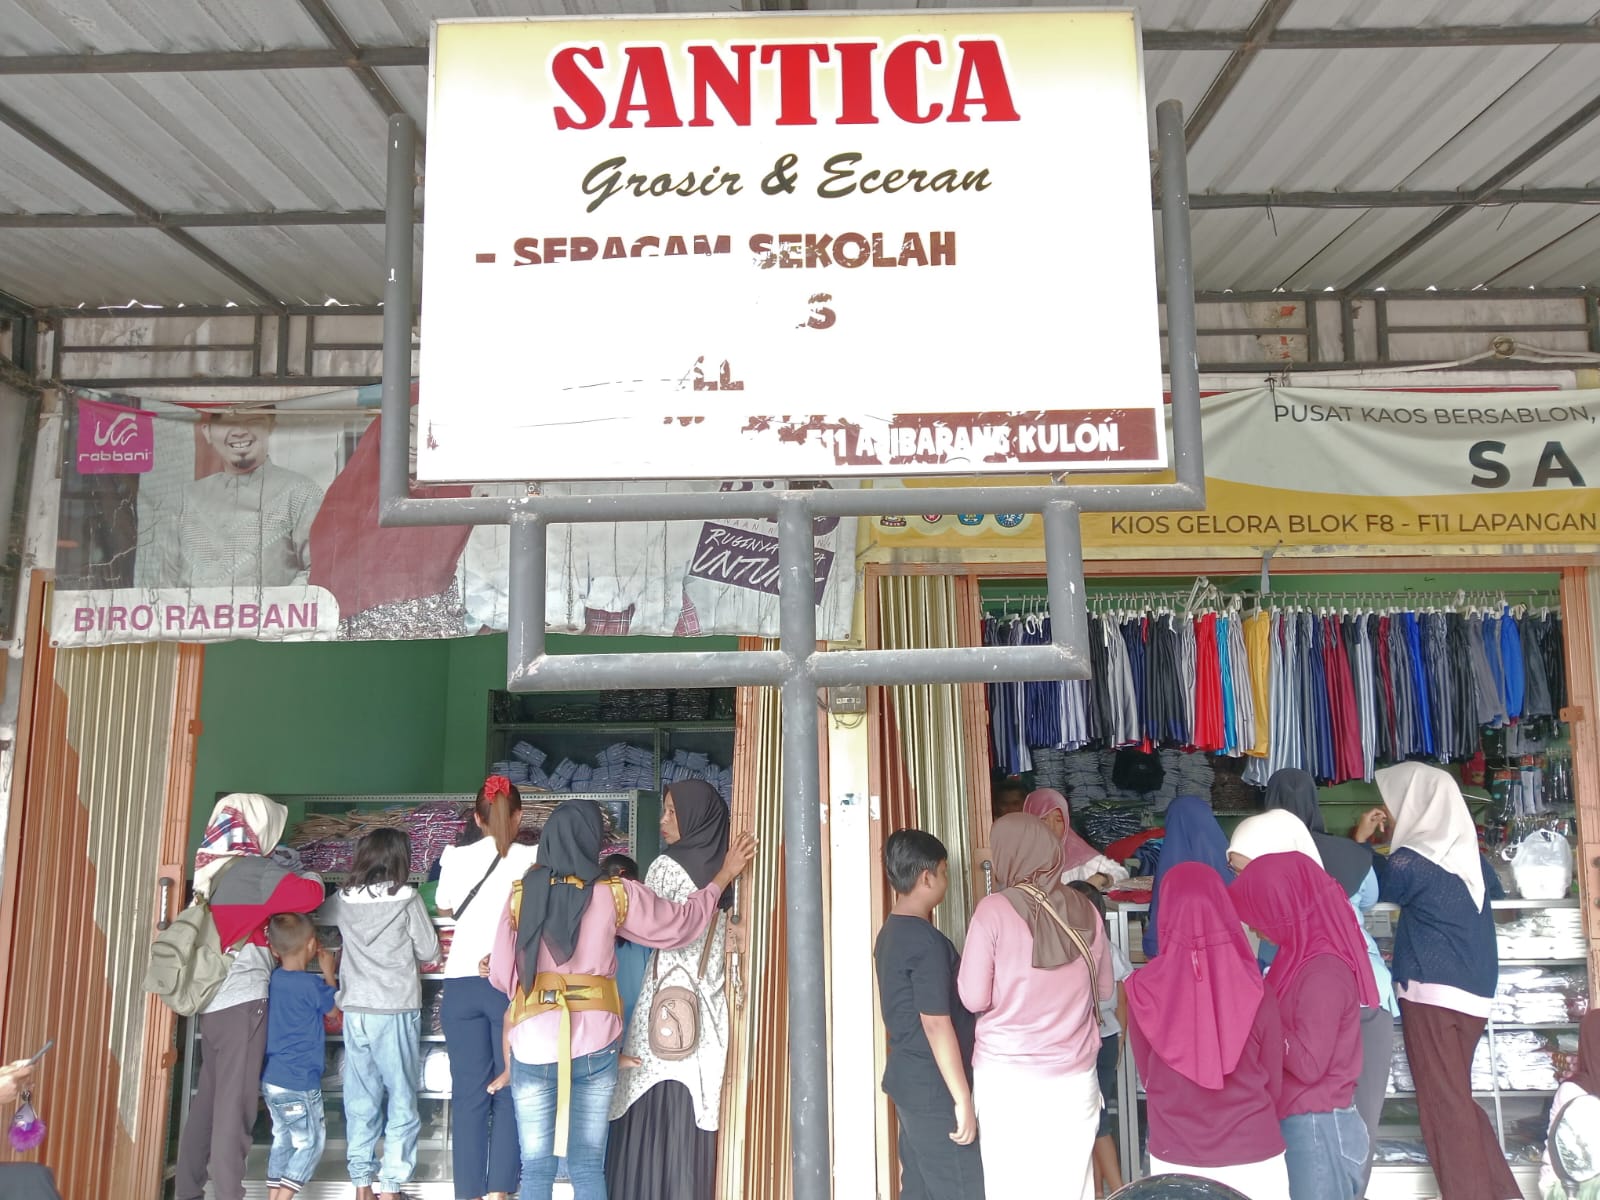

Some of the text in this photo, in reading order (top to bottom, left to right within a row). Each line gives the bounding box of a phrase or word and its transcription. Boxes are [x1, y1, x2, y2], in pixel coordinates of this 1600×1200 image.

[551, 38, 1021, 131] SANTICA
[581, 152, 992, 213] Grosir & Eceran
[748, 231, 956, 269] SEKOLAH
[1274, 404, 1596, 425] PUSAT KAOS BERSABLON,
[1019, 422, 1119, 453] KULON
[79, 448, 151, 462] rabbani
[1111, 515, 1170, 534] KIOS
[1177, 514, 1281, 534] GELORA
[1289, 513, 1359, 534] BLOK
[1366, 513, 1395, 533] F8
[1418, 513, 1450, 533] F11
[1459, 512, 1597, 533] LAPANGAN
[73, 602, 319, 632] BIRO RABBANI
